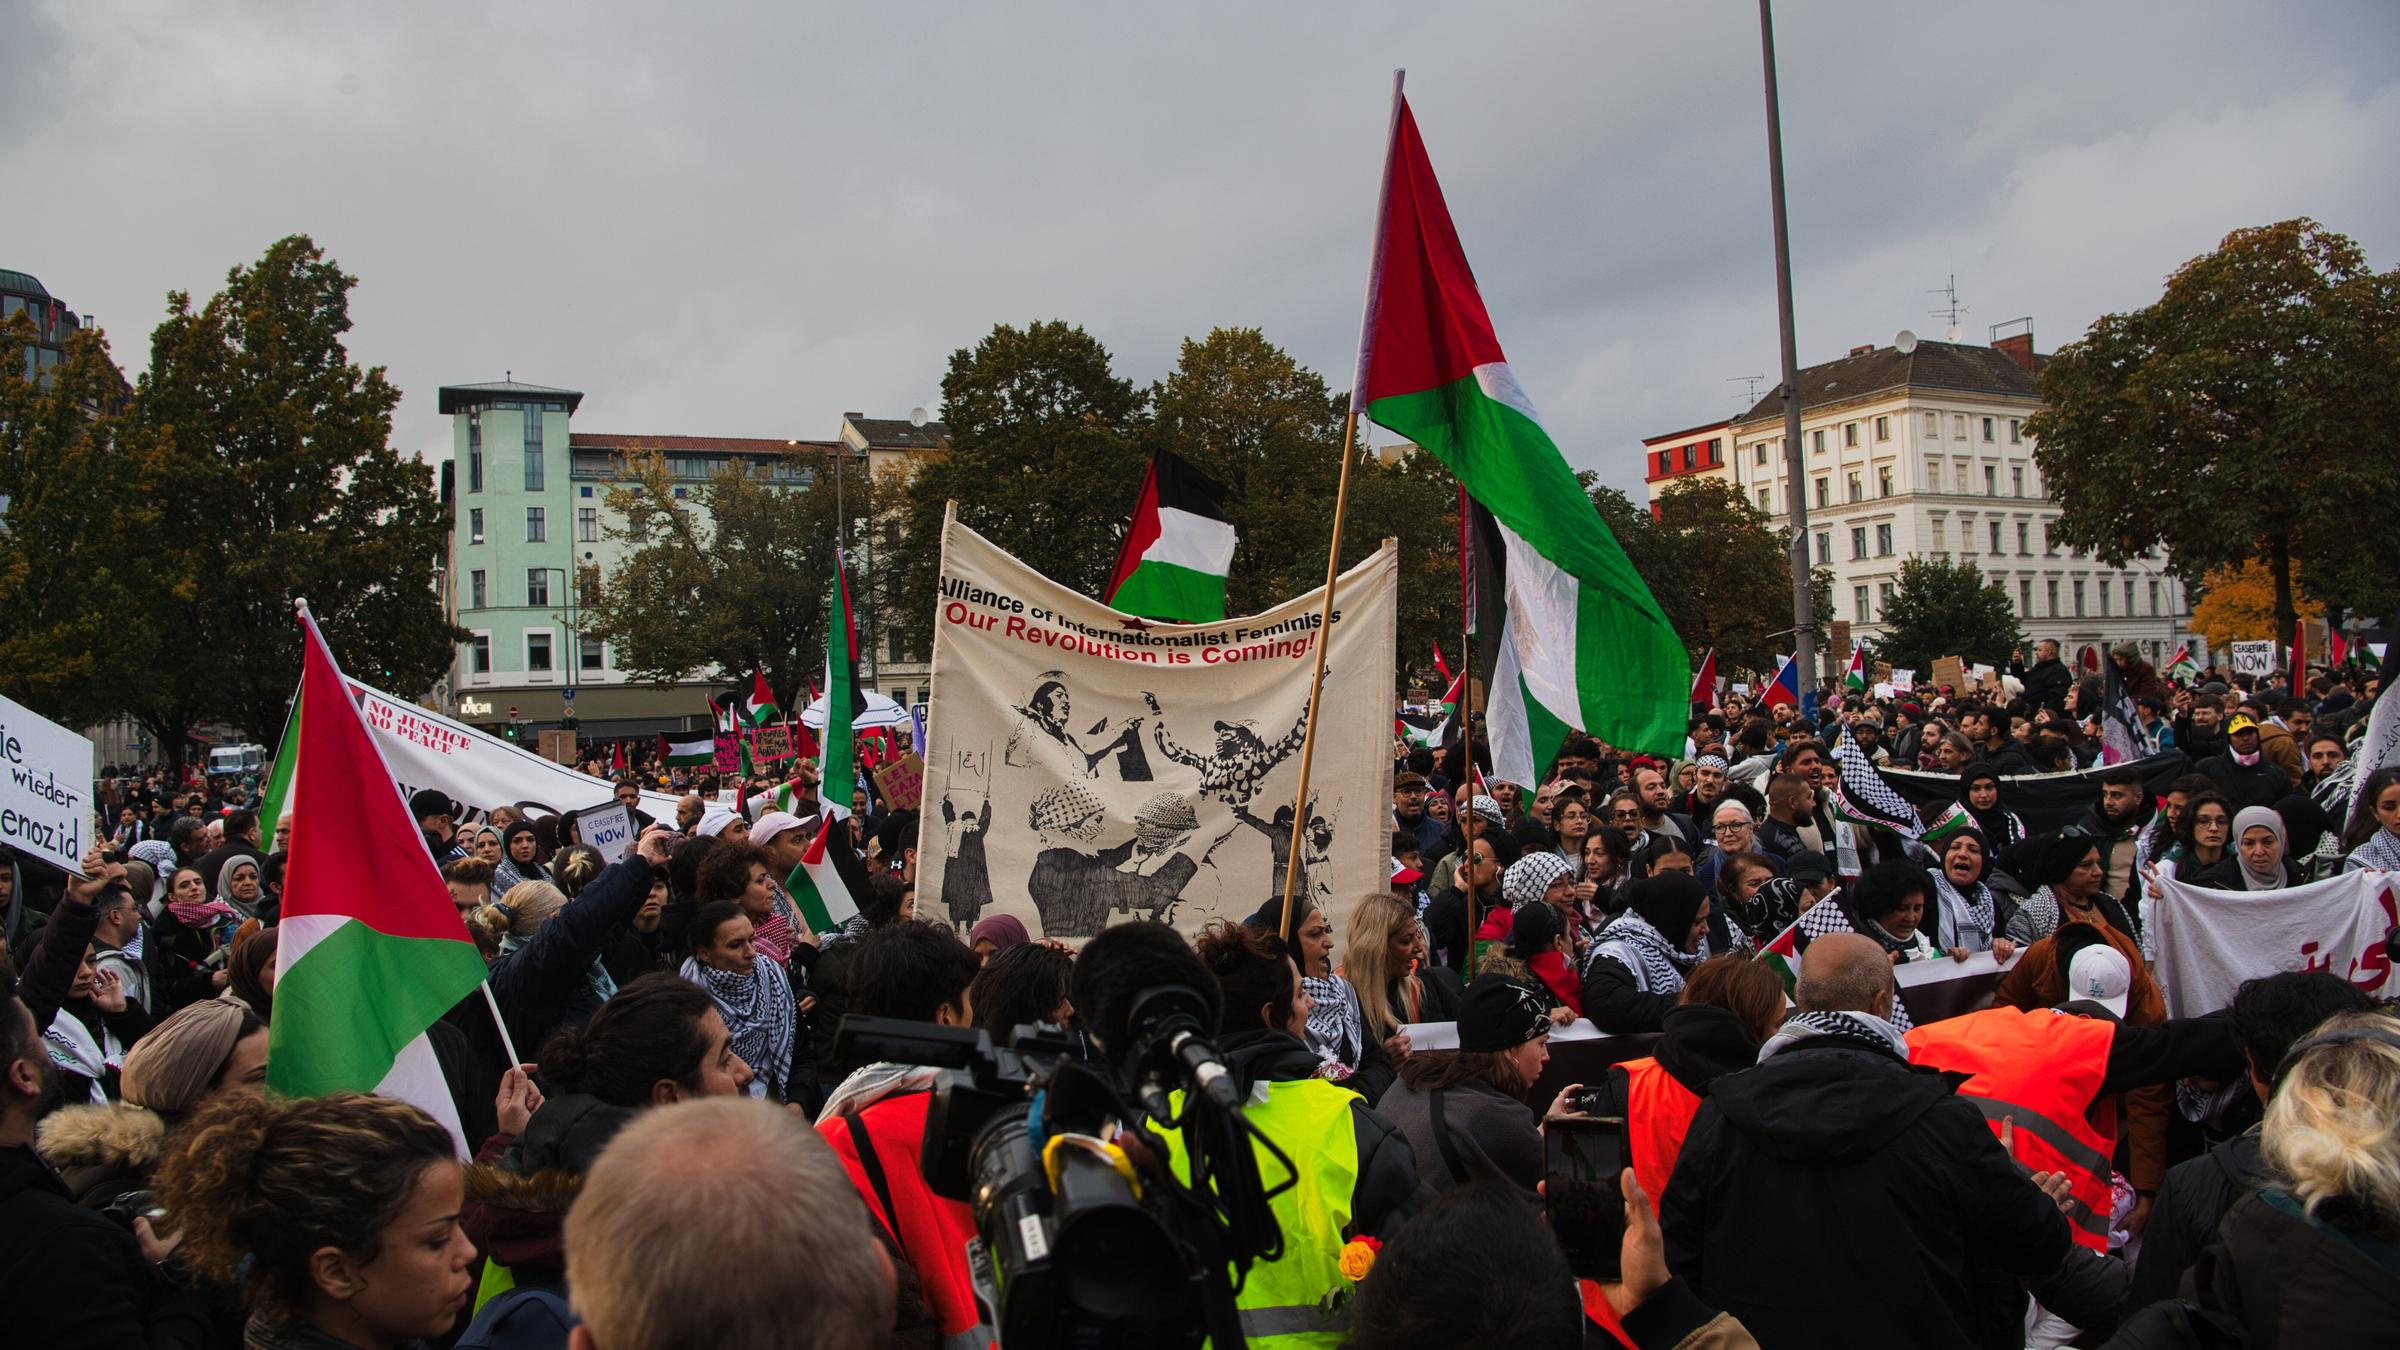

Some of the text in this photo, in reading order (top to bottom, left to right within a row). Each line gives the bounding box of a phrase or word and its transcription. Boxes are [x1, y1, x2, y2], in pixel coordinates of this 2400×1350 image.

[939, 576, 1342, 647] Alliance of Internationalist Feminiss
[945, 602, 1316, 664] Our Revolution is Coming!
[2236, 654, 2267, 671] NOW
[366, 711, 452, 755] NO PEACE
[368, 700, 471, 751] NO JUSTICE
[12, 768, 78, 808] wieder
[883, 763, 909, 785] LET
[894, 786, 922, 809] LIV
[1, 808, 78, 862] enozid
[594, 825, 625, 846] NOW
